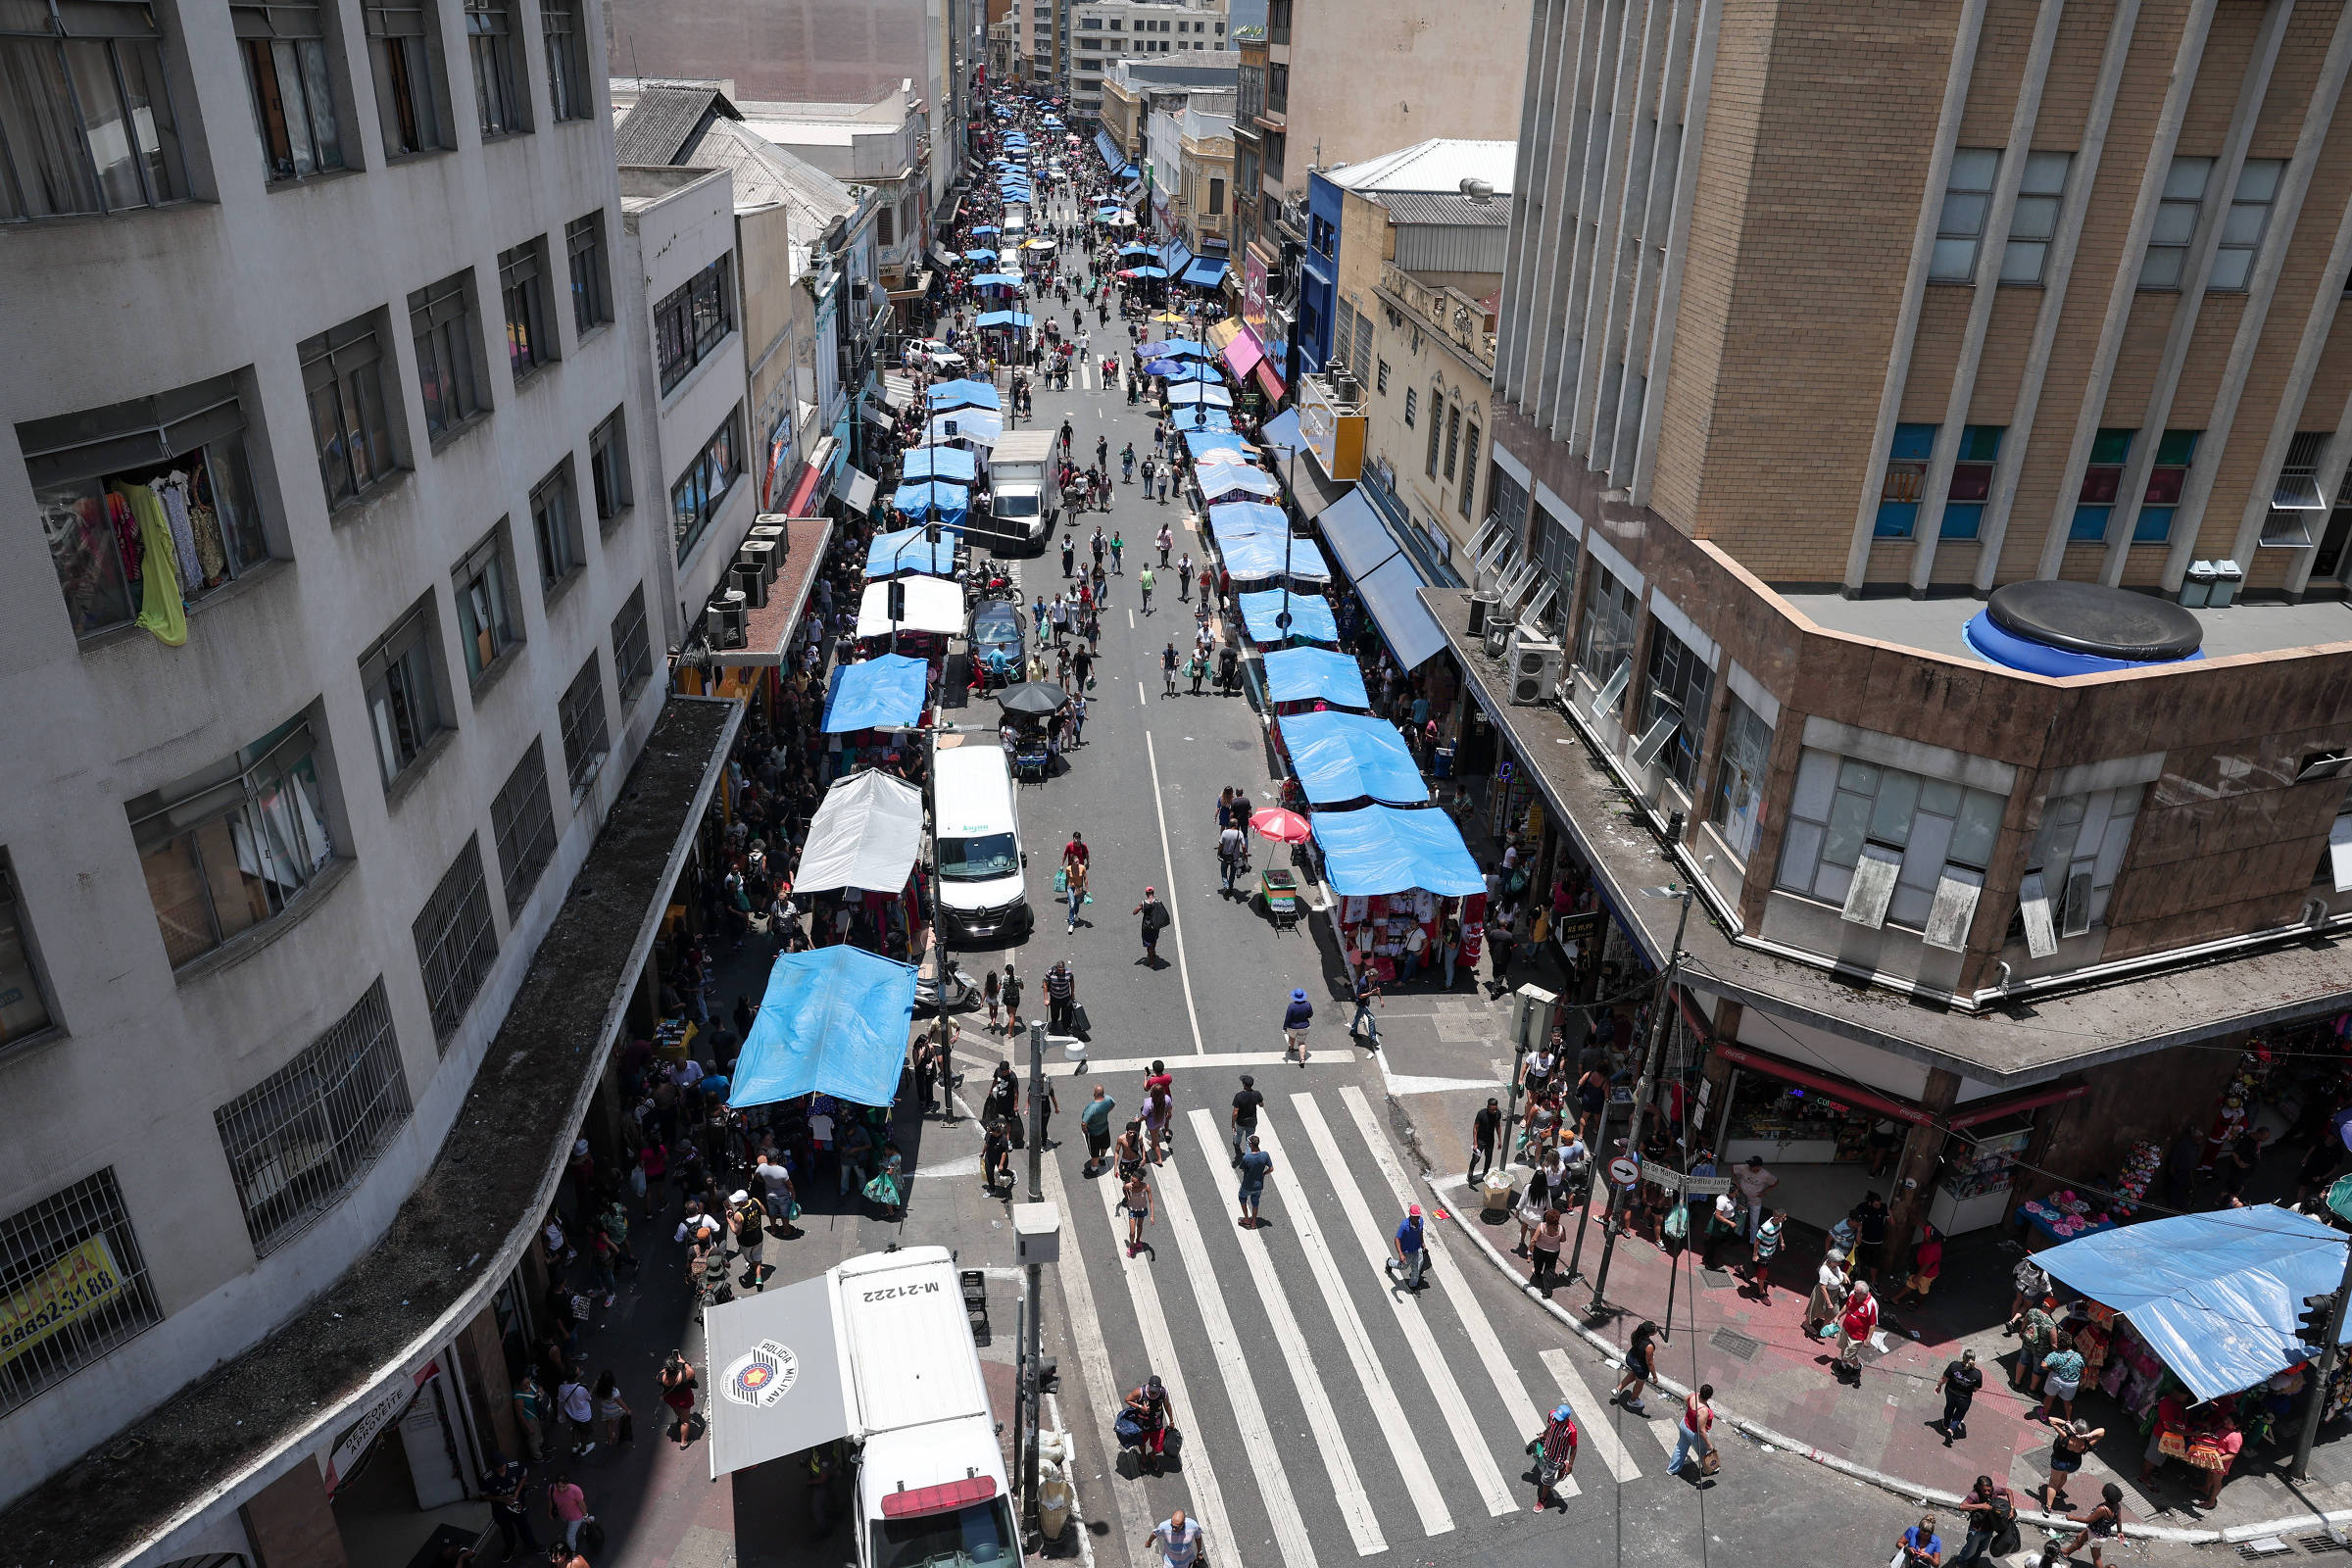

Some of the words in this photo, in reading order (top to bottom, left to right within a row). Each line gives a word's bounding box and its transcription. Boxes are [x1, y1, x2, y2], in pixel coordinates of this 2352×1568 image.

[1642, 1161, 1650, 1170] 25
[1660, 1167, 1678, 1181] Março
[863, 1281, 940, 1303] M-21222
[766, 1368, 795, 1403] MILITAR
[345, 1392, 397, 1448] DESCON
[351, 1390, 404, 1454] APROVEITE
